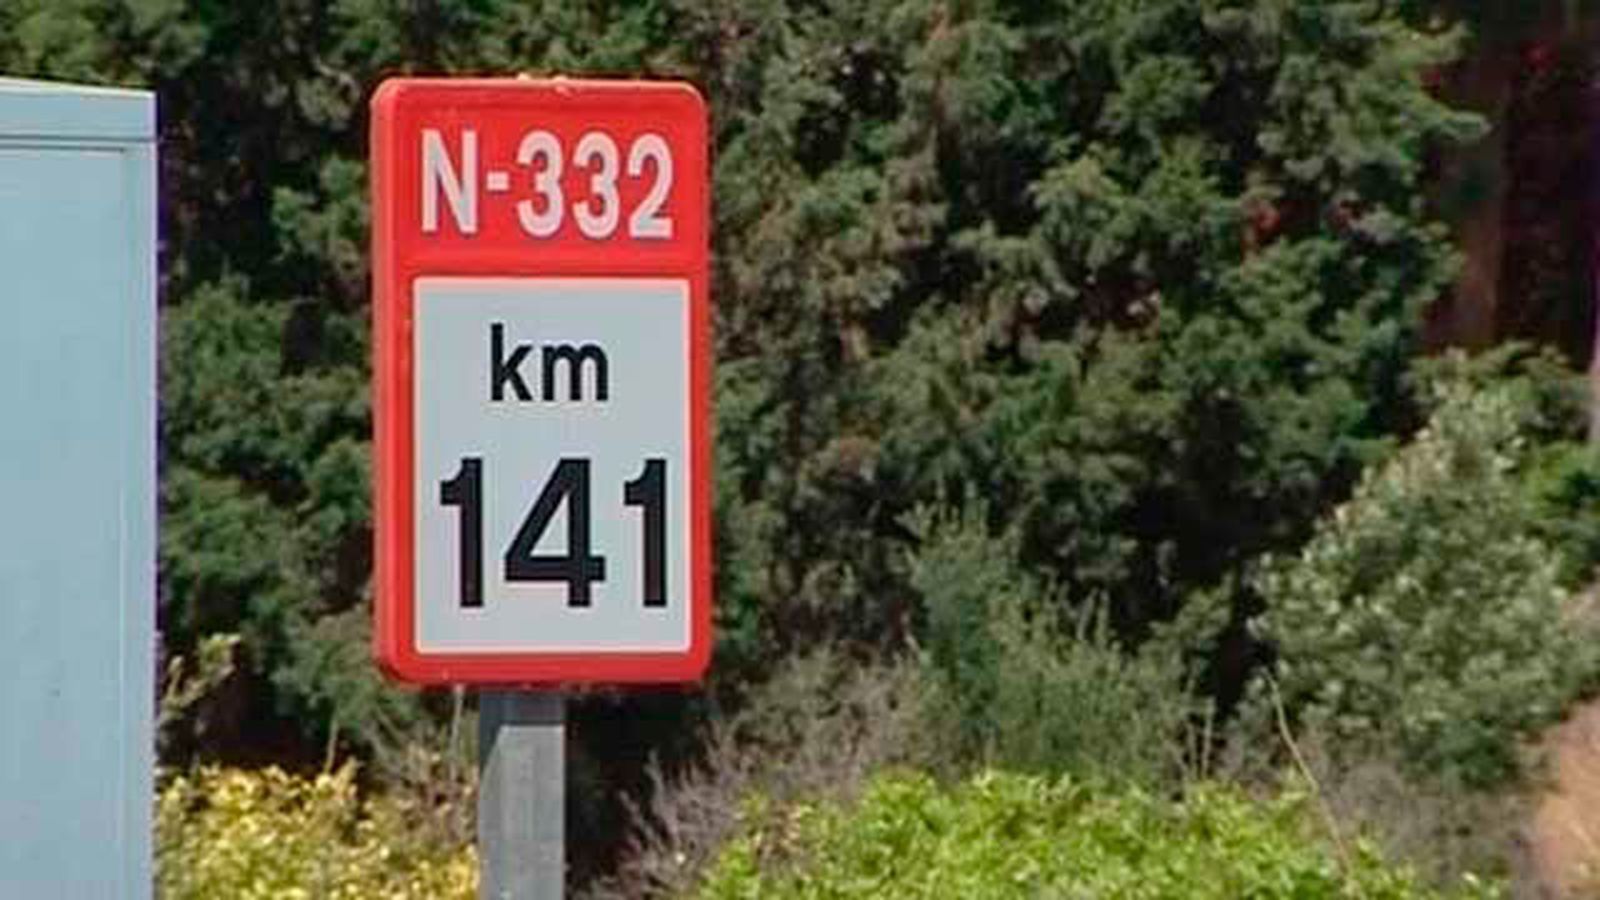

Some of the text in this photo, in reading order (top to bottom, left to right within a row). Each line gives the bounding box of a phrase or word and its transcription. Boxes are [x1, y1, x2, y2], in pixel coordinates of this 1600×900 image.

[421, 128, 674, 239] N-332
[490, 322, 609, 402] km
[439, 457, 668, 608] 141
